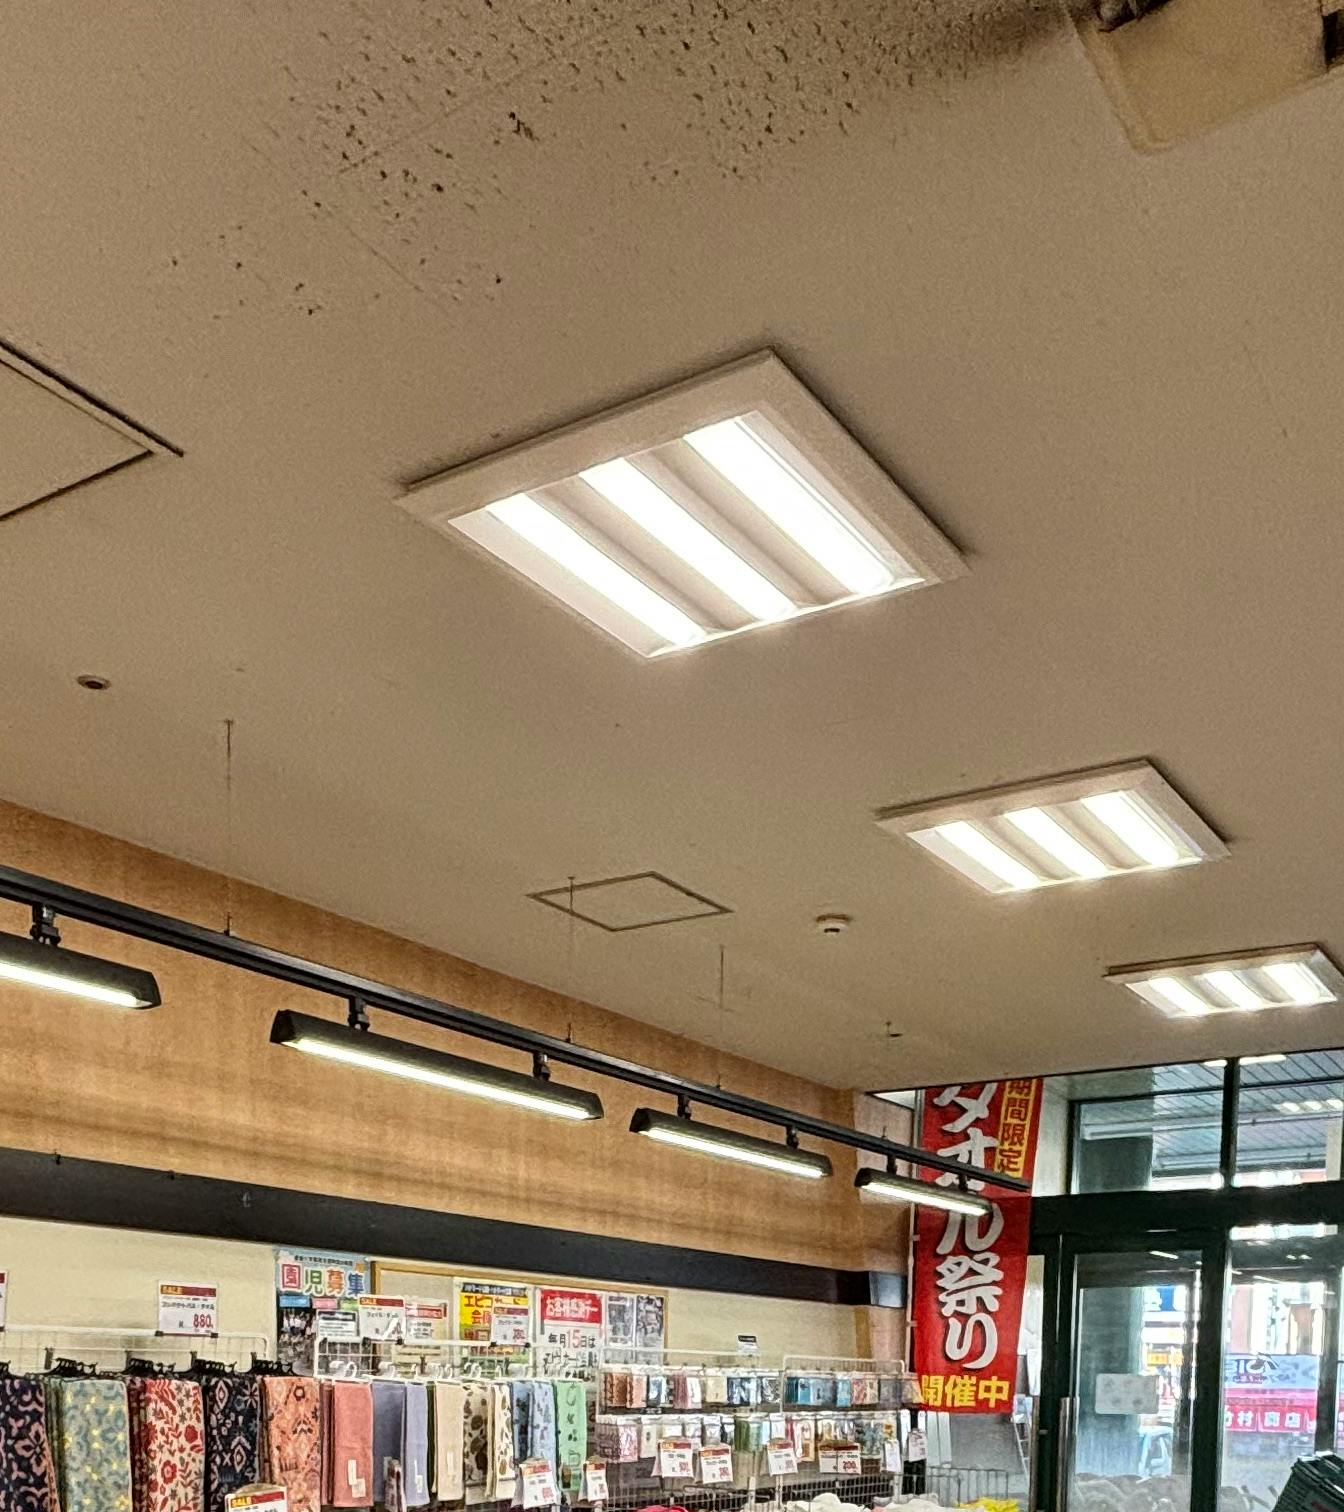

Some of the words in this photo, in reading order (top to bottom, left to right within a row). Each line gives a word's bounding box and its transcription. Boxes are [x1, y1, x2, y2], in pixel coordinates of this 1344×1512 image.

[933, 1082, 1005, 1369] タオル祭り
[281, 1263, 365, 1297] 園児募集
[921, 1374, 1010, 1408] 開催中
